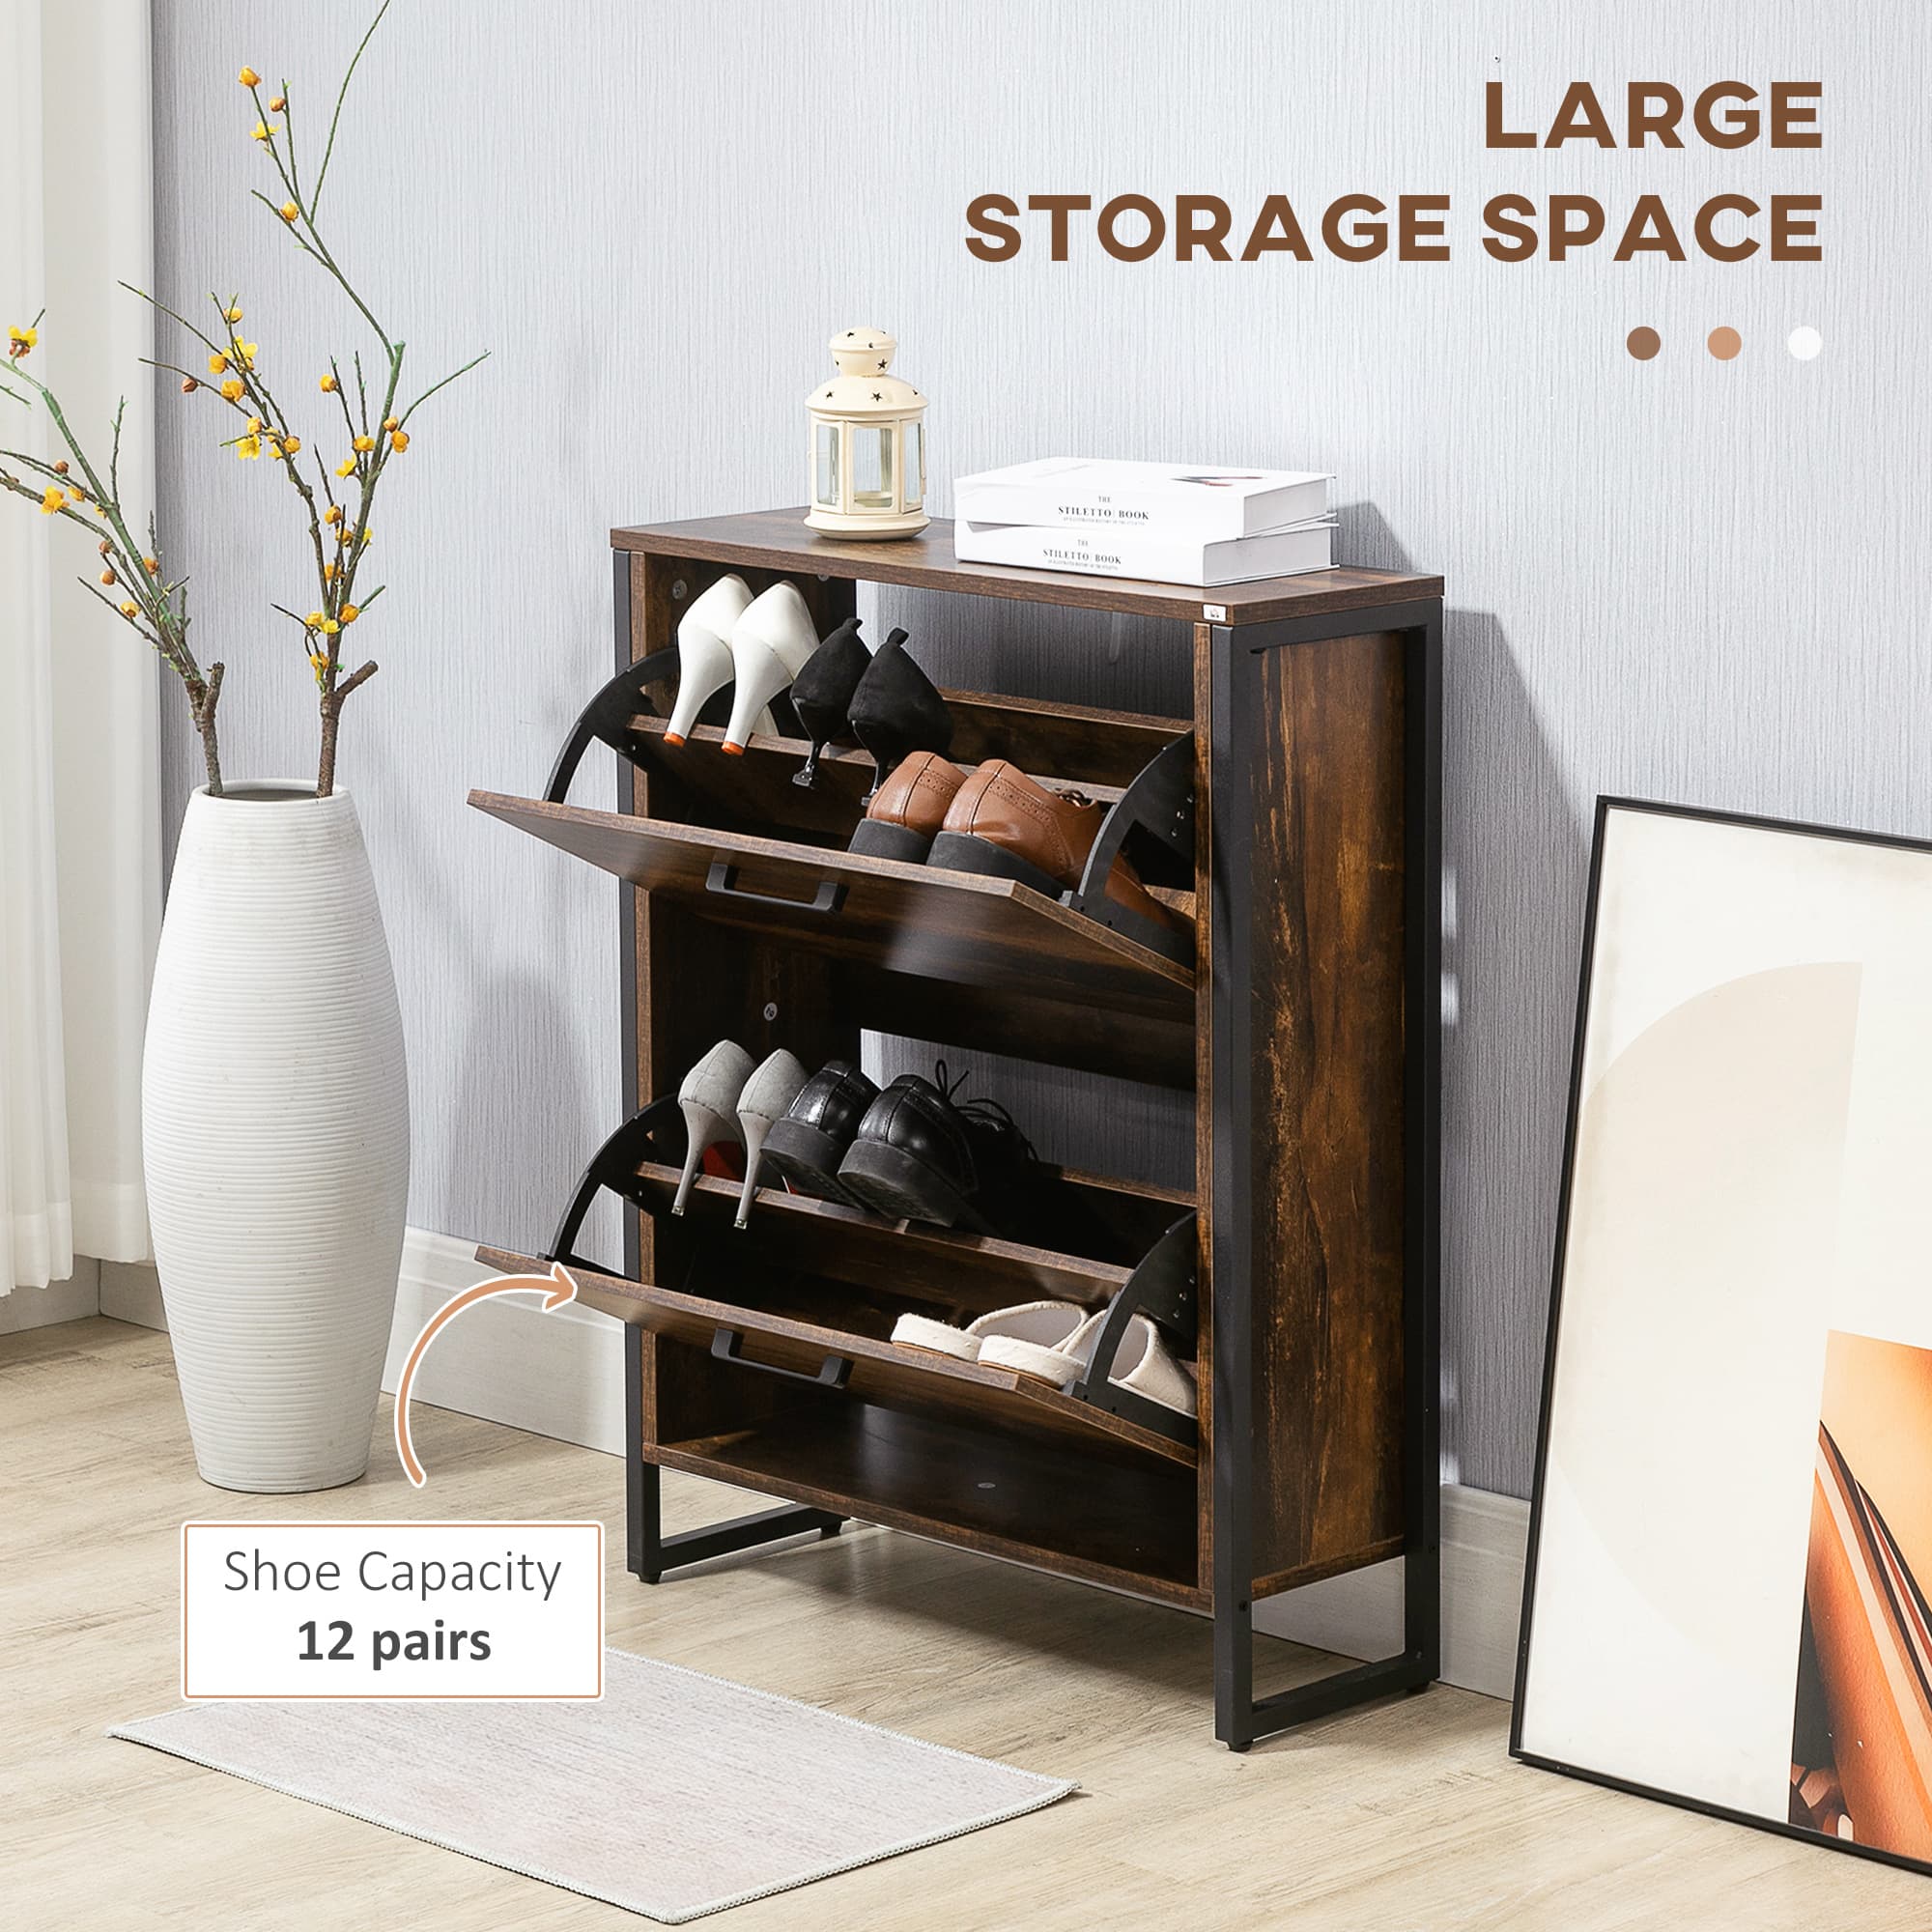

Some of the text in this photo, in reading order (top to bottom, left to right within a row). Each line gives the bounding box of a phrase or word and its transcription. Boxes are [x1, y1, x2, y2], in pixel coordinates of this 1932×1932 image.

[1098, 495, 1111, 503] THE
[1058, 505, 1150, 521] STILETTO BOOK
[1042, 549, 1090, 561] STILETTO
[1094, 554, 1122, 565] BOOK
